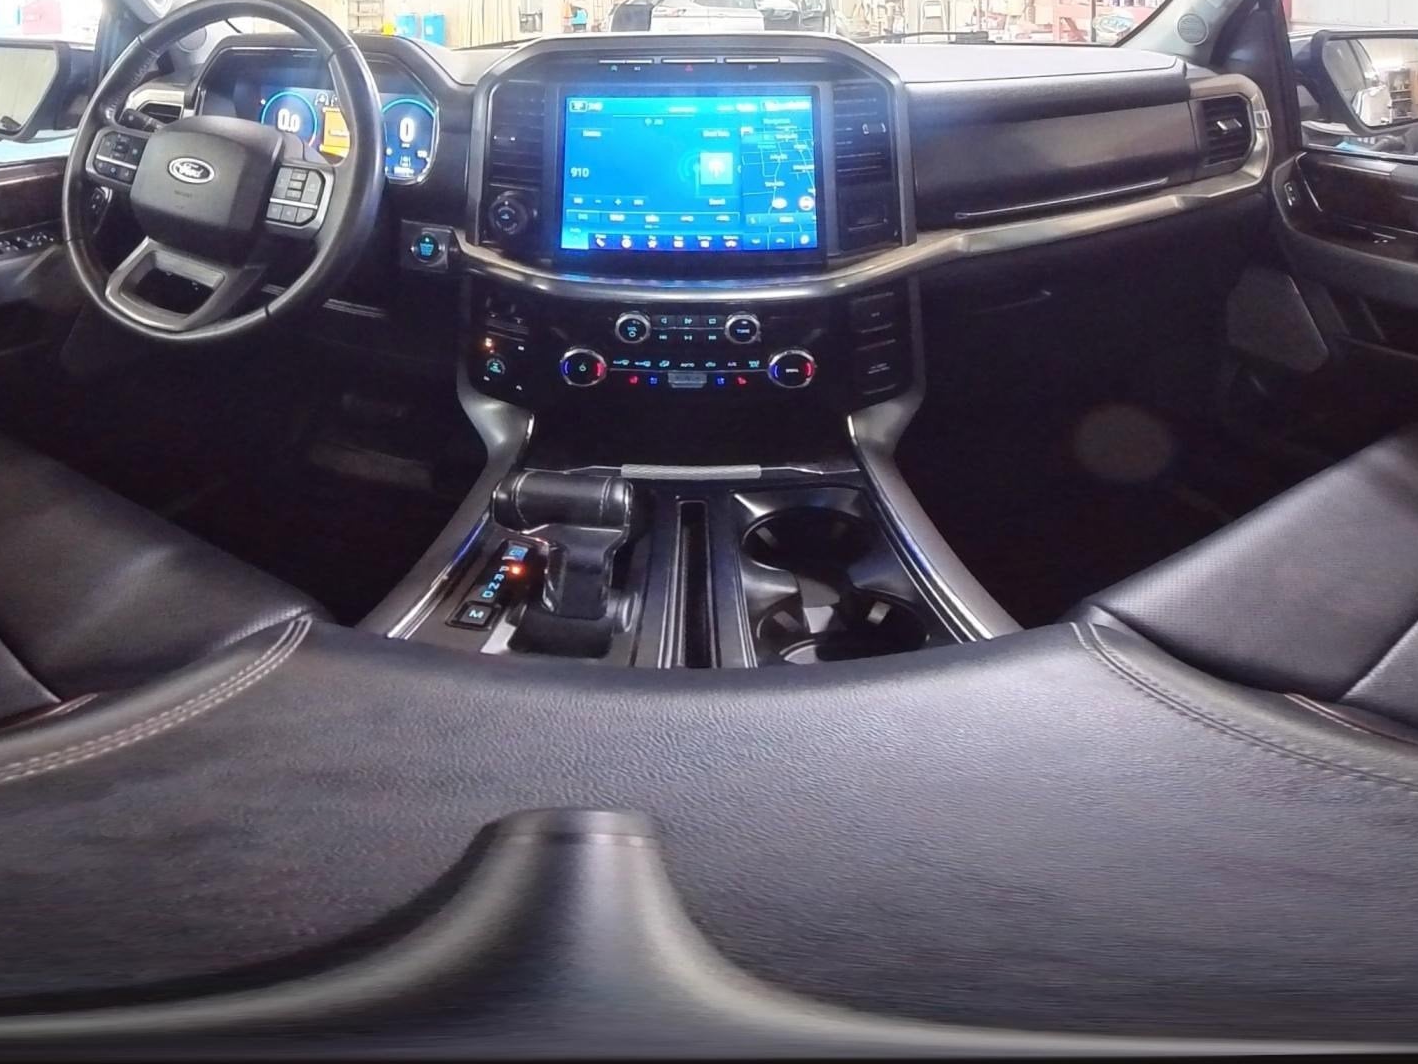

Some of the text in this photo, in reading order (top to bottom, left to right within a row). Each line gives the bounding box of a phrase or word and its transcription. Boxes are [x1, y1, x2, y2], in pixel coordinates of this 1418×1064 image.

[277, 108, 300, 133] 0.0
[399, 117, 415, 143] 0
[173, 162, 204, 179] Ford
[570, 167, 590, 179] 910
[469, 609, 484, 618] M
